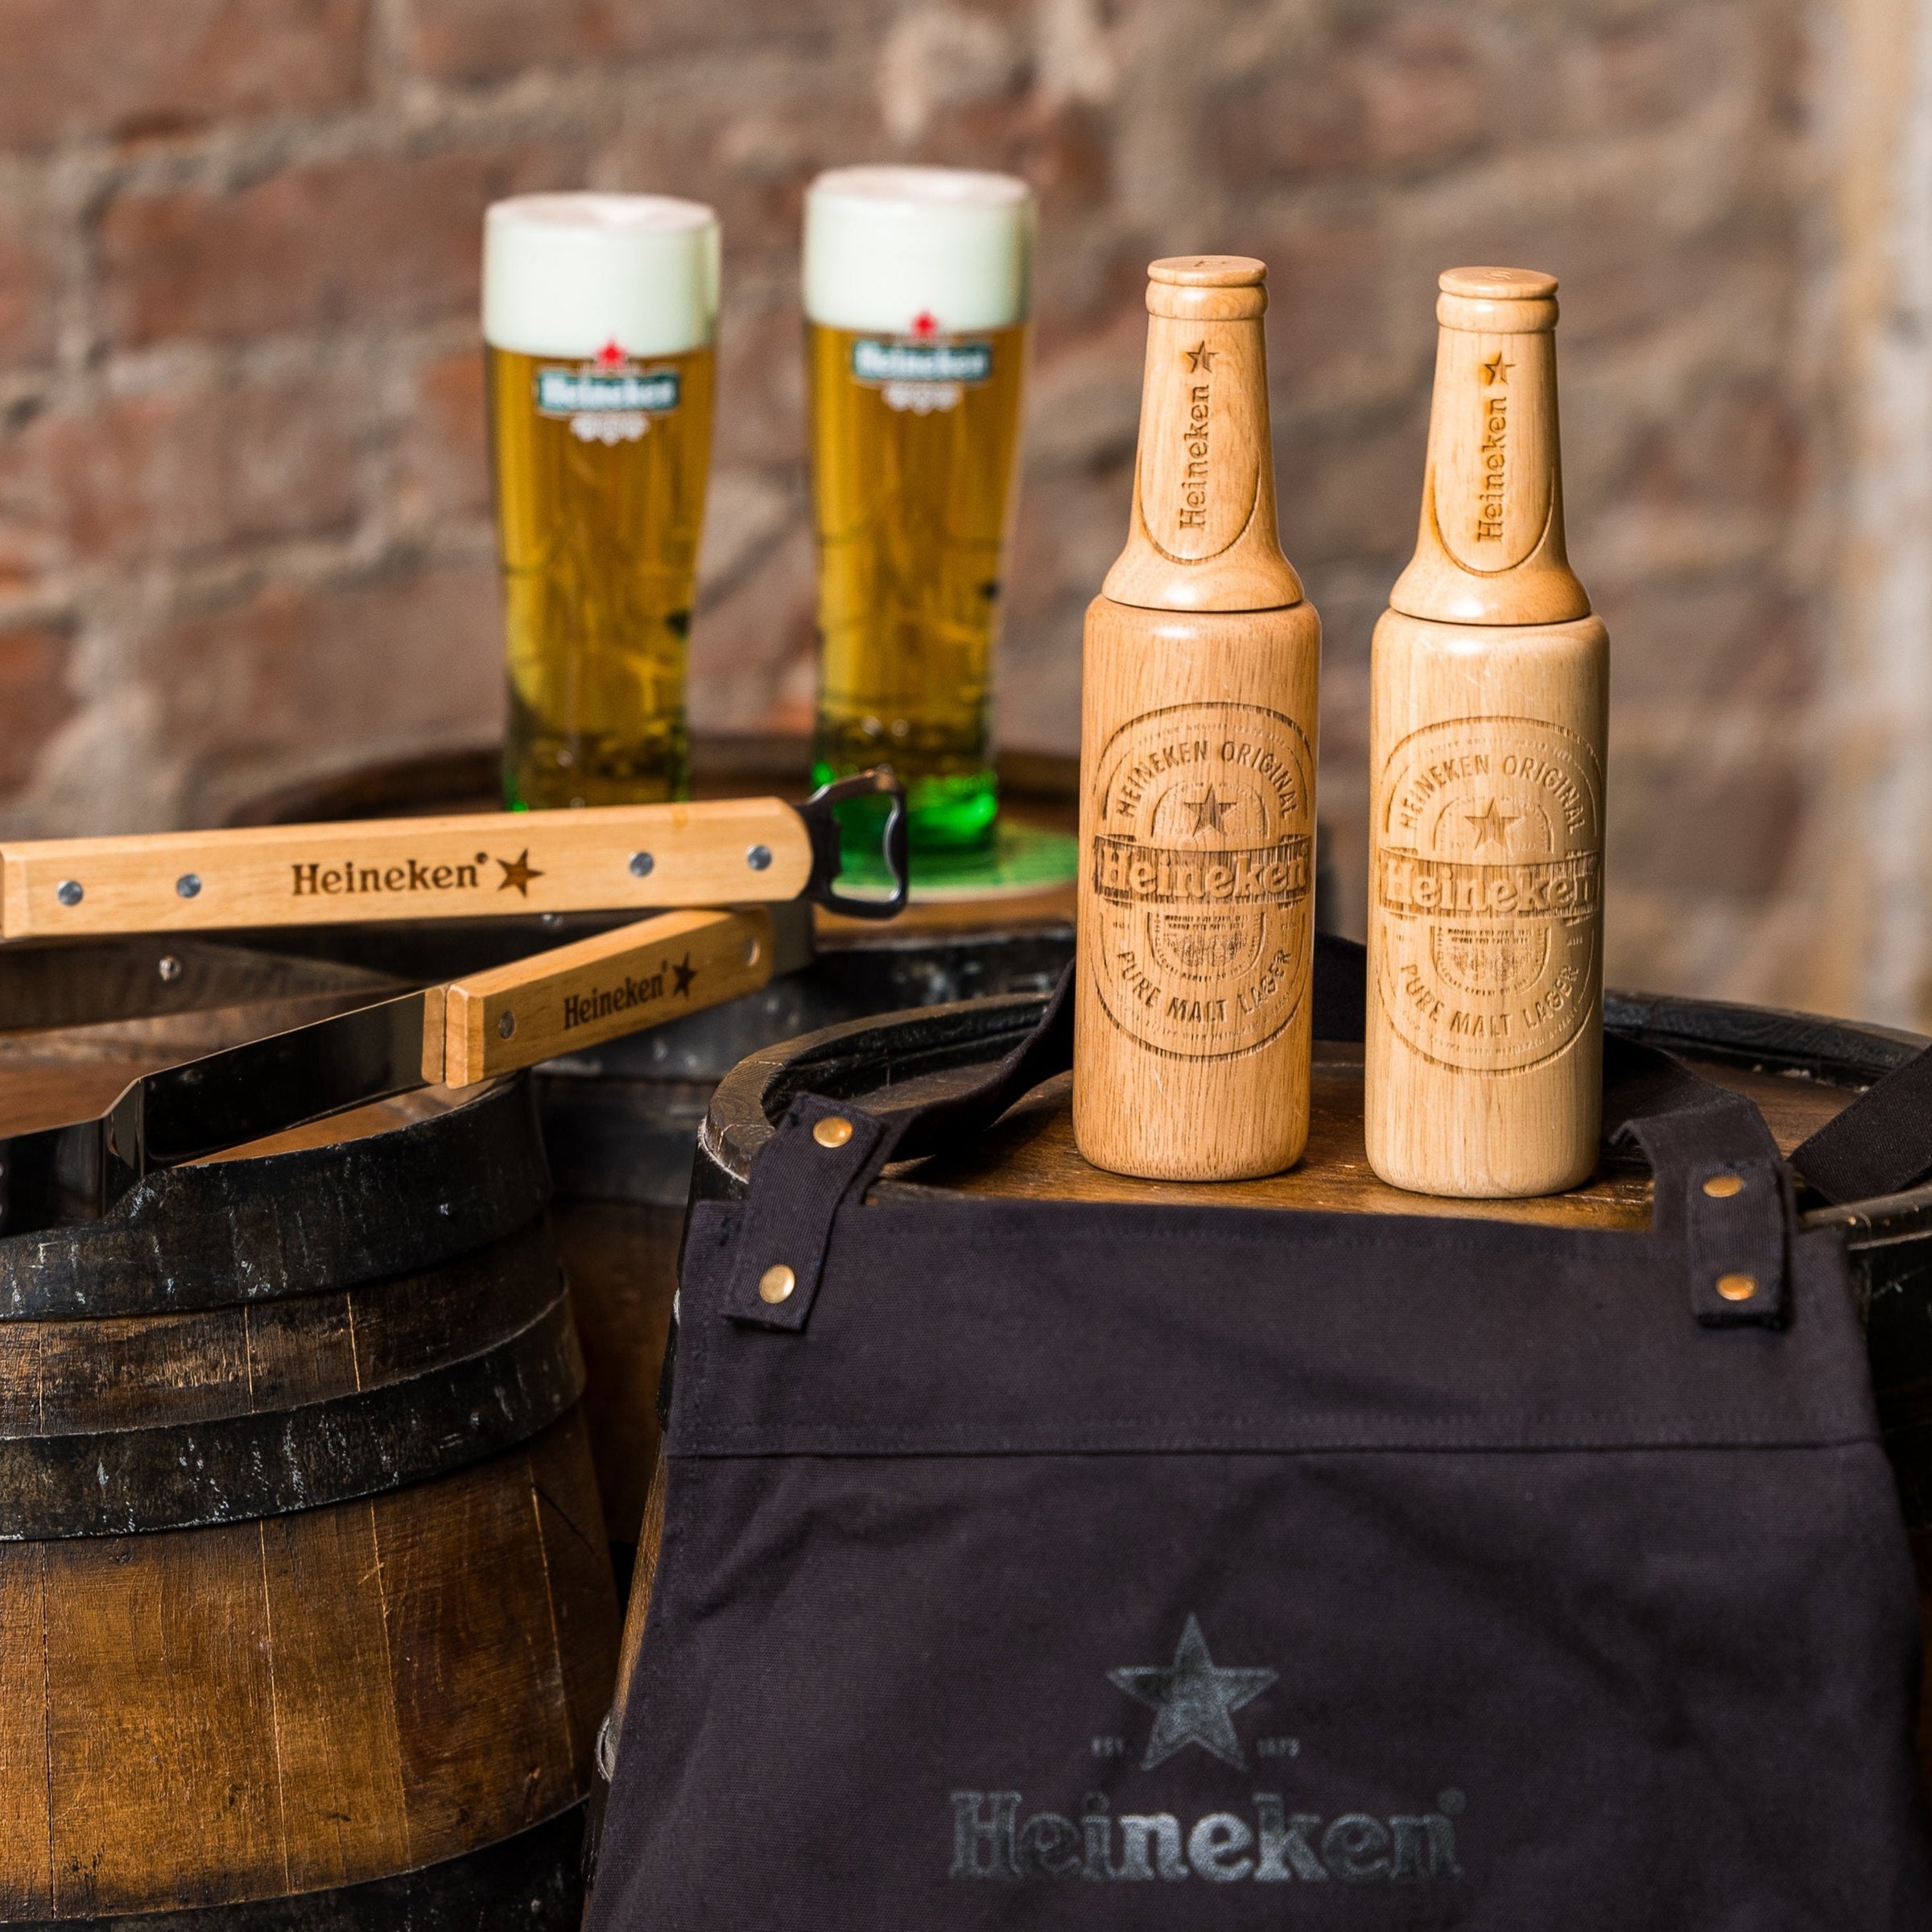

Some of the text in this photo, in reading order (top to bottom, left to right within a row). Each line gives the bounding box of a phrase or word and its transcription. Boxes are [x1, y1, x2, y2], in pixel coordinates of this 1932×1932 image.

[1179, 384, 1210, 530] Heineken
[1477, 396, 1507, 543] Heineken
[1117, 740, 1209, 819] HEINEKEN
[1221, 741, 1298, 820] ORIGINAL
[1399, 754, 1489, 830] HEINEKEN
[1503, 755, 1586, 835] ORIGINAL
[292, 857, 481, 895] Heineken
[1101, 848, 1308, 898] Heineken
[1385, 860, 1598, 913] Heineken
[564, 971, 665, 1030] Heineken
[1116, 949, 1162, 1008] PURE
[1166, 996, 1228, 1023] MALT
[1238, 949, 1293, 1016] LAGER
[1401, 964, 1445, 1023] PURE
[1451, 1011, 1513, 1038] MALT
[1525, 967, 1579, 1030] LAGER
[948, 1790, 1463, 1882] Heineken
